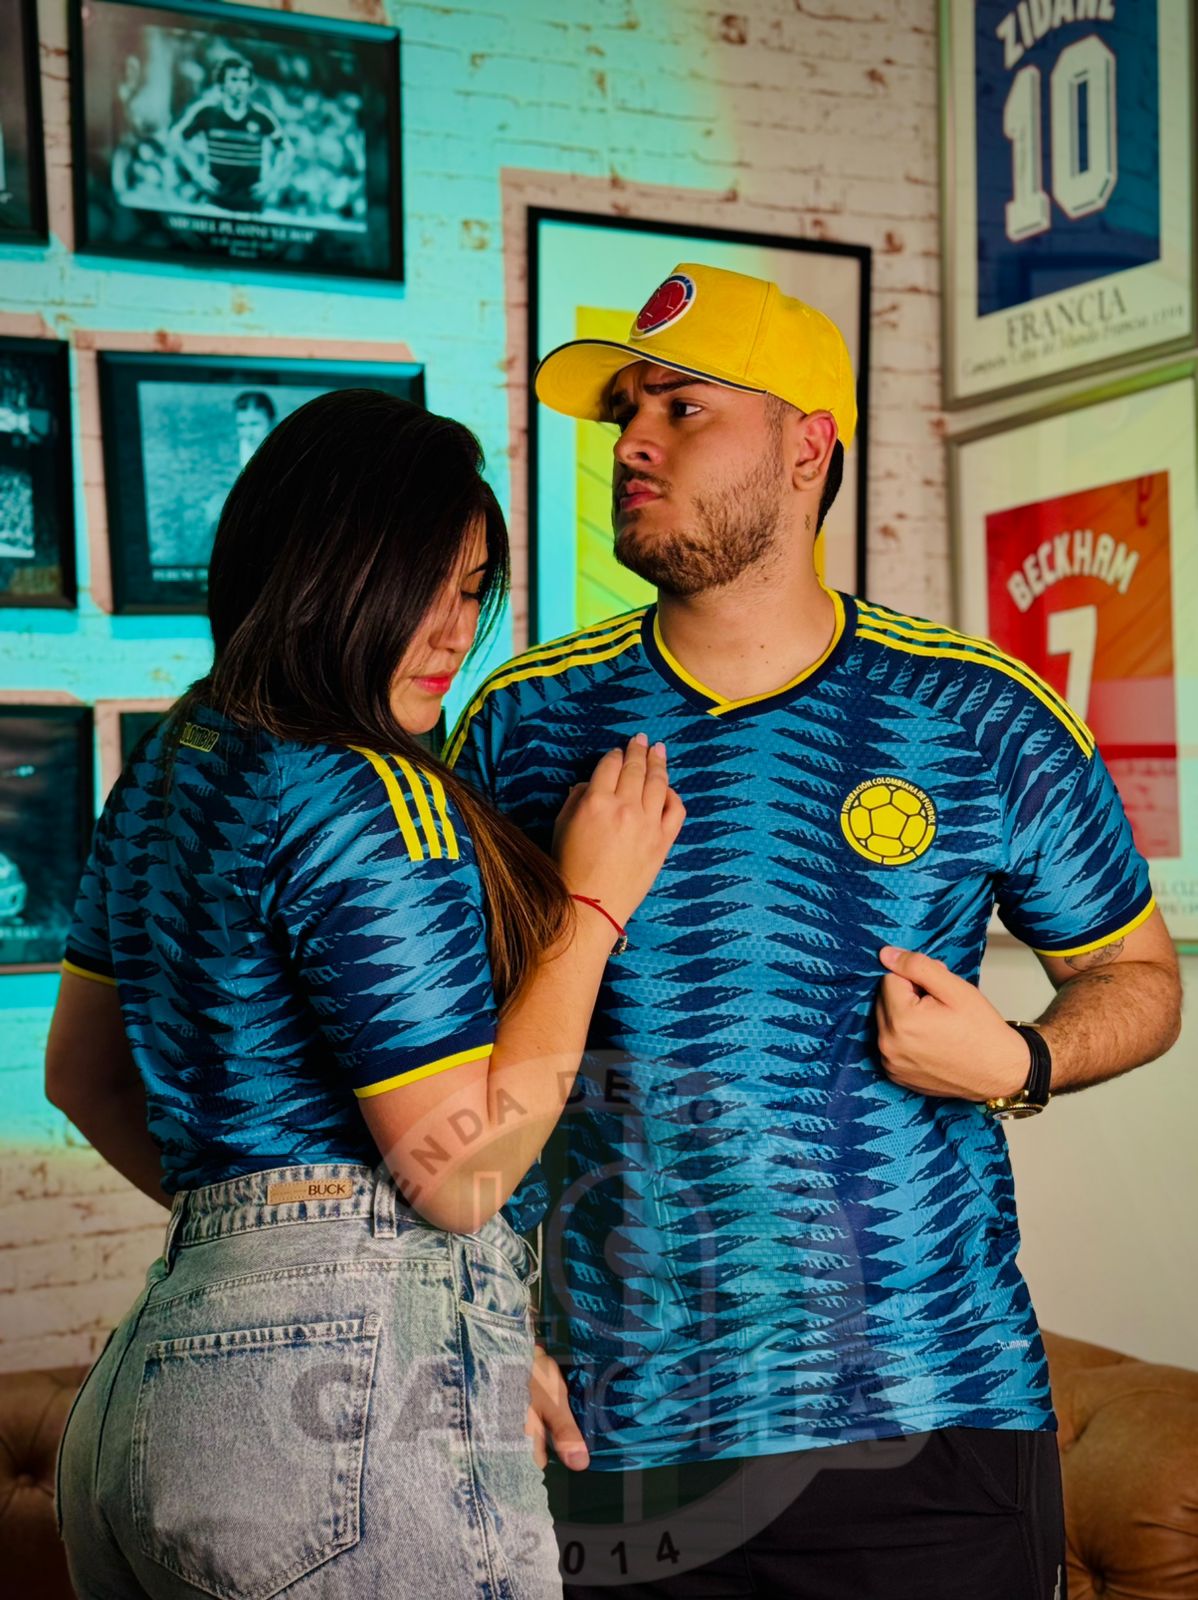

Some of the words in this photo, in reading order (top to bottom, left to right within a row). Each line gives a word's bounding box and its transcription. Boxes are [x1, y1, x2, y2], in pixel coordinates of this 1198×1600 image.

[1002, 34, 1119, 243] 10
[1006, 287, 1126, 349] FRANCIA
[1006, 530, 1141, 614] BECKHAM
[1047, 605, 1098, 729] 7
[871, 776, 918, 795] COLOMBIANA
[916, 789, 927, 801] DE
[308, 1183, 346, 1196] BUCK
